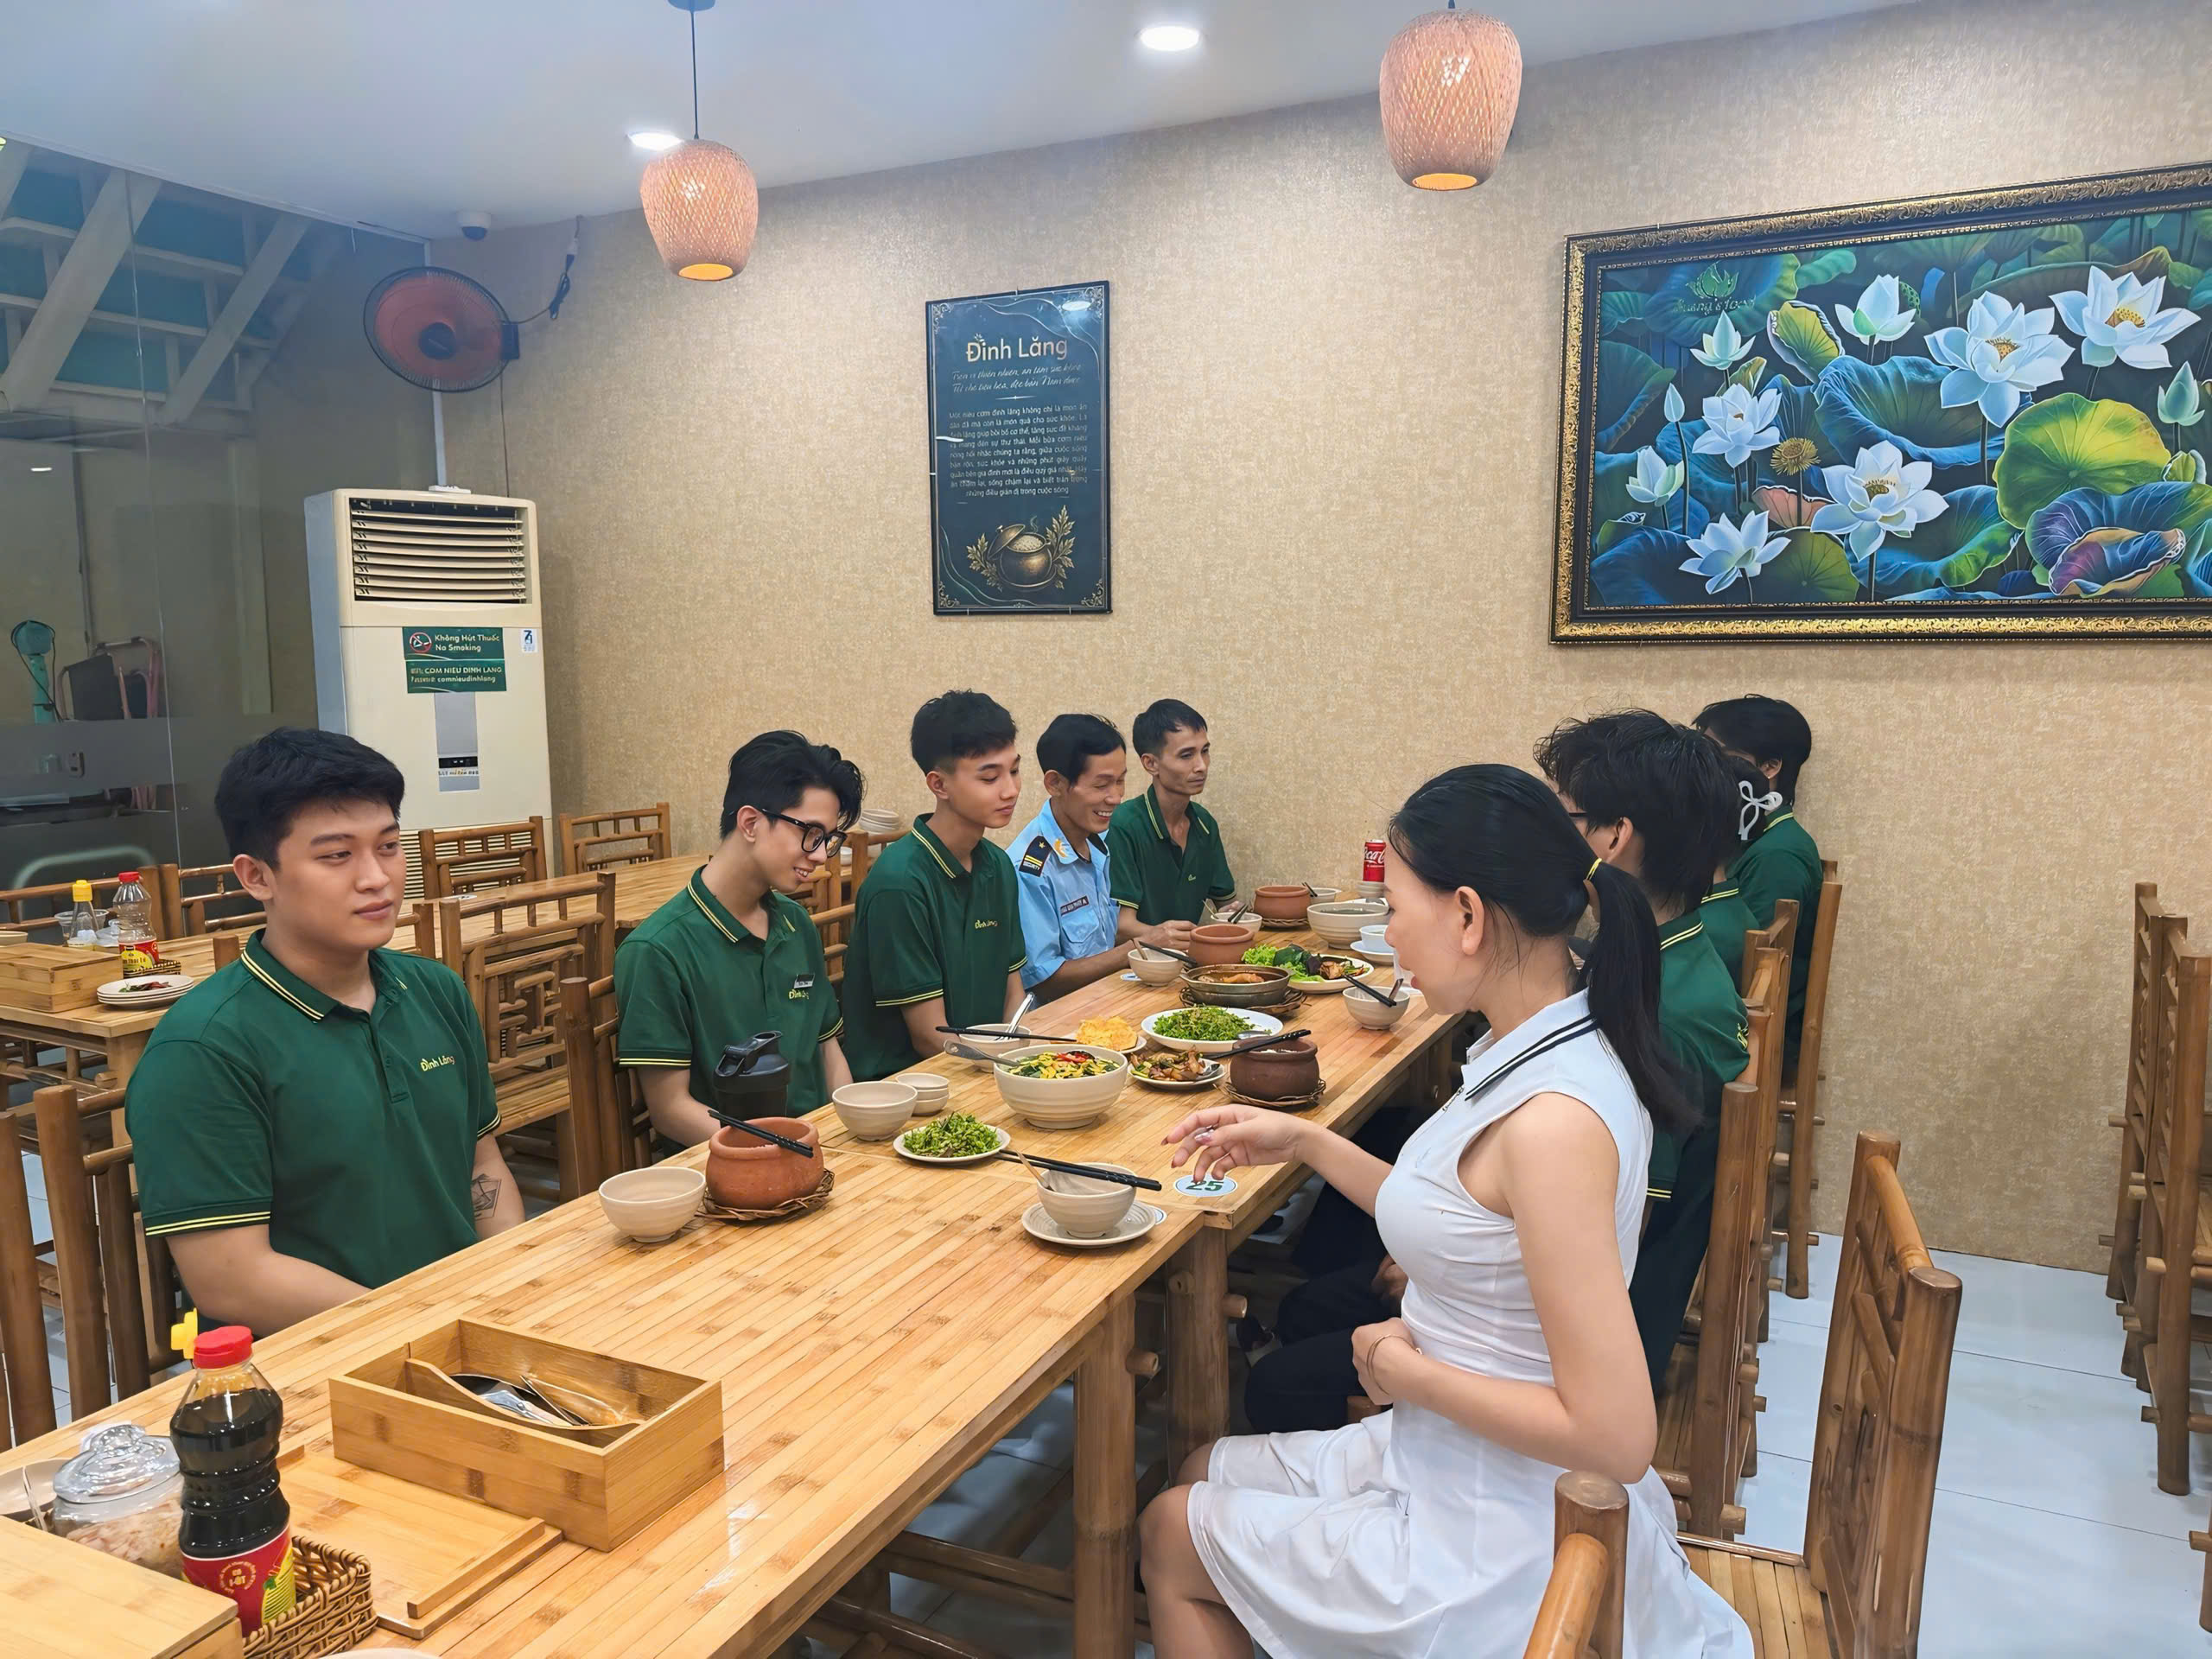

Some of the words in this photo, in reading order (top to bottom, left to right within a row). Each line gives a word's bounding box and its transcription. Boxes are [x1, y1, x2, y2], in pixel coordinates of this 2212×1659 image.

[1019, 336, 1067, 360] Lăng
[435, 634, 460, 643] Không
[448, 644, 481, 652] Smoking
[1185, 1180, 1224, 1192] 25
